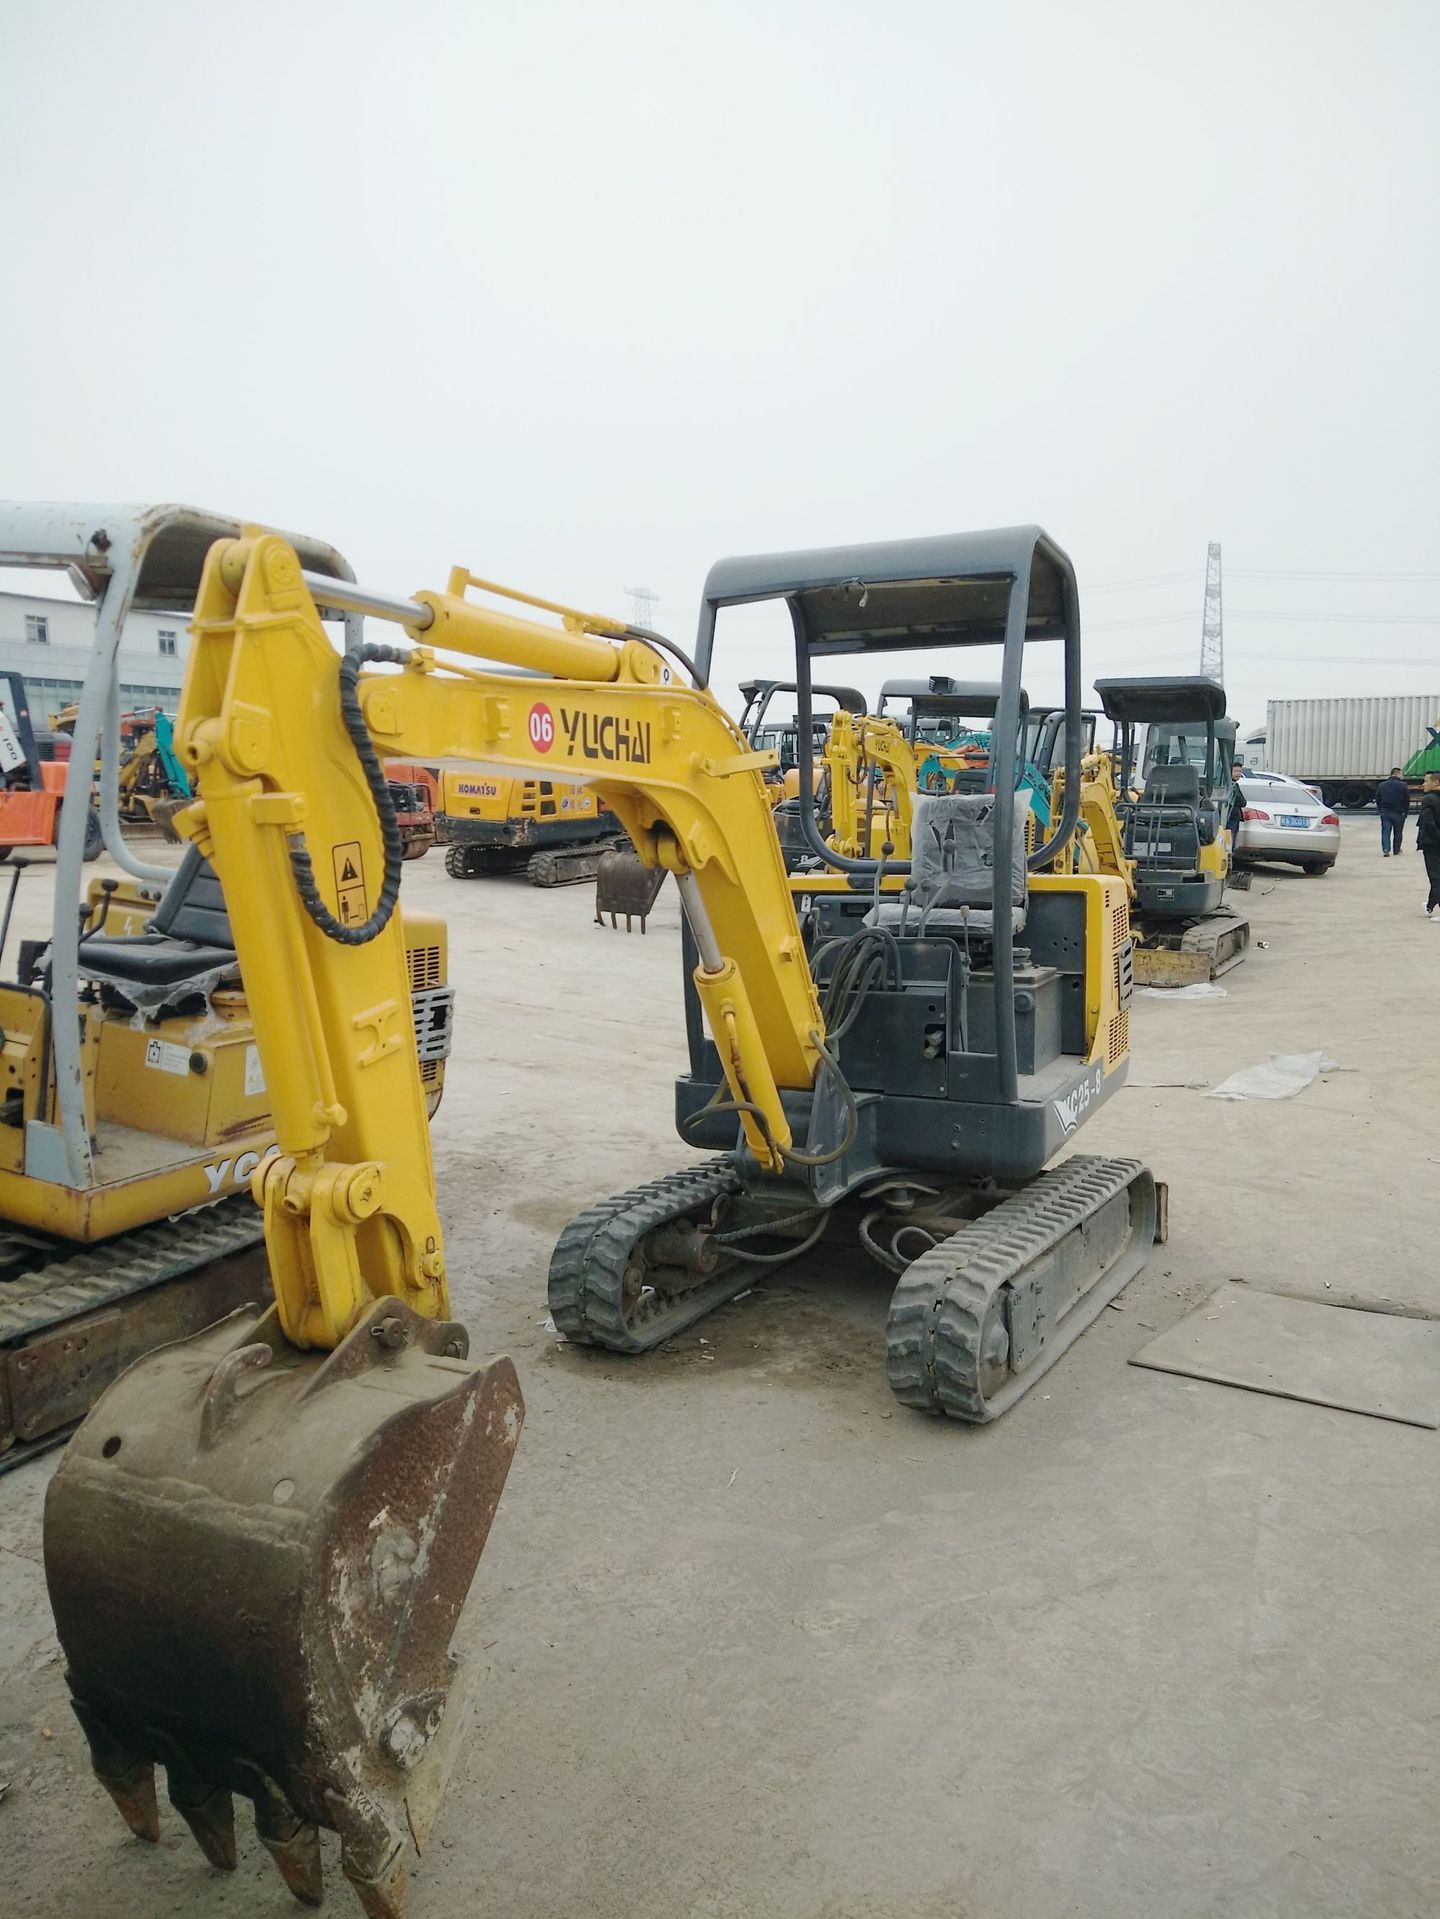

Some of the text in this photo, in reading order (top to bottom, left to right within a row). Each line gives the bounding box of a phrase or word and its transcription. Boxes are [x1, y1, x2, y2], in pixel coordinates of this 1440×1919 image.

[530, 712, 553, 742] 06
[560, 708, 651, 764] YUCHAI
[458, 782, 497, 796] KOMATSU
